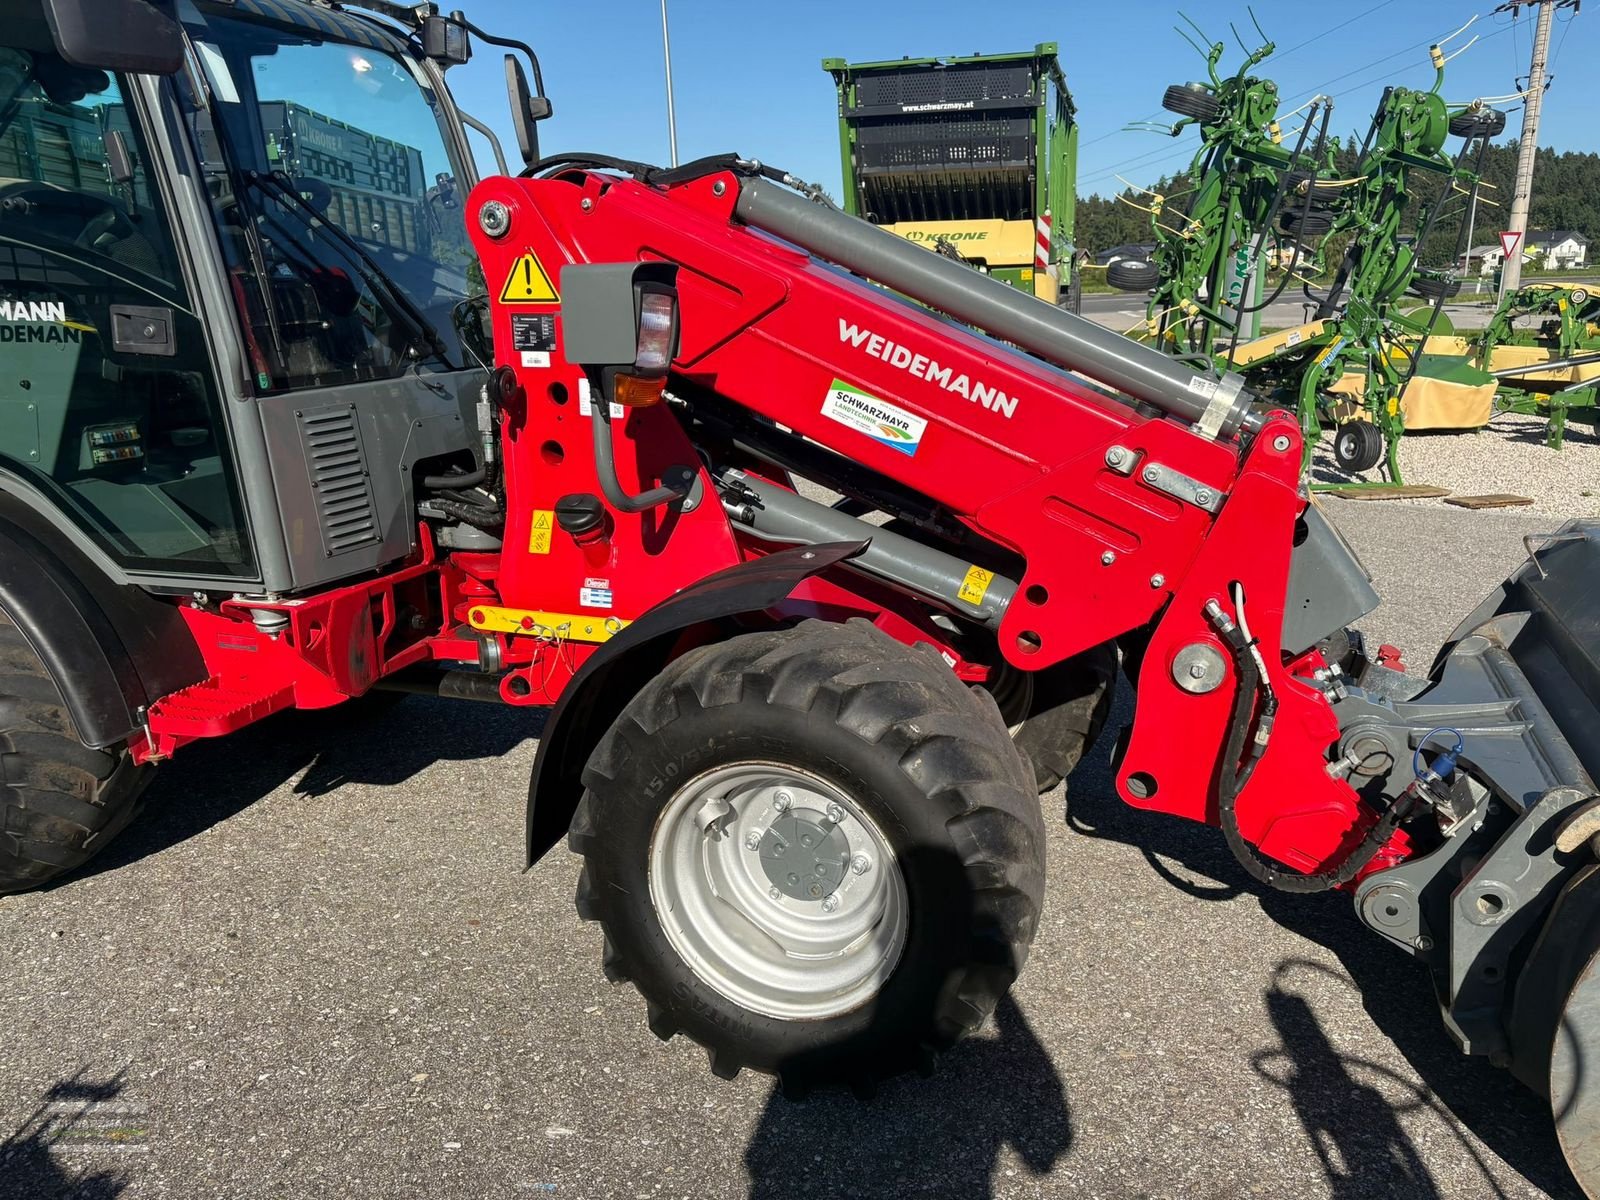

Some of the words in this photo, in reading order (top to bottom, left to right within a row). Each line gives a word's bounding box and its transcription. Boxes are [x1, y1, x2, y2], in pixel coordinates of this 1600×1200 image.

[925, 231, 988, 242] KRONE
[839, 318, 1019, 419] WEIDEMANN
[835, 401, 877, 426] LANDTECHNIK
[836, 391, 909, 431] SCHWARZMAYR
